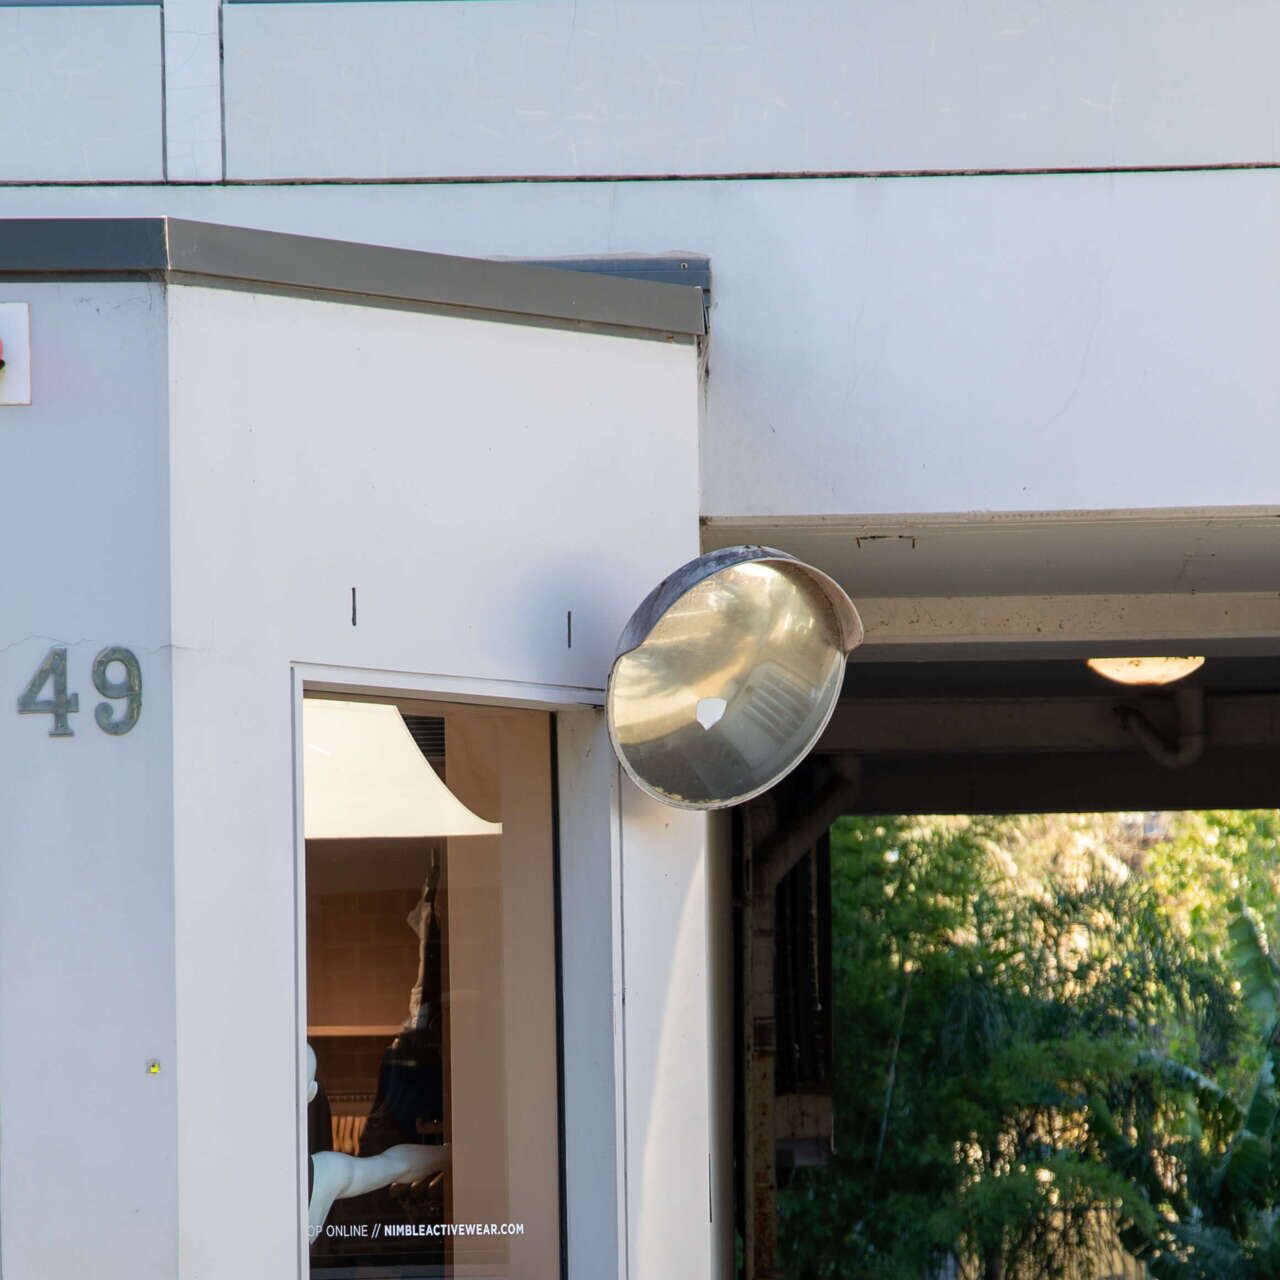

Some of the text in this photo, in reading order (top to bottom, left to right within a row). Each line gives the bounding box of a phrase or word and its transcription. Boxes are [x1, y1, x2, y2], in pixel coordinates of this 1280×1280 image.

[17, 645, 142, 737] 49
[307, 1225, 322, 1237] OP
[326, 1224, 368, 1237] ONLINE
[384, 1223, 524, 1237] NIMBLEACTIVEWEAR.COM
